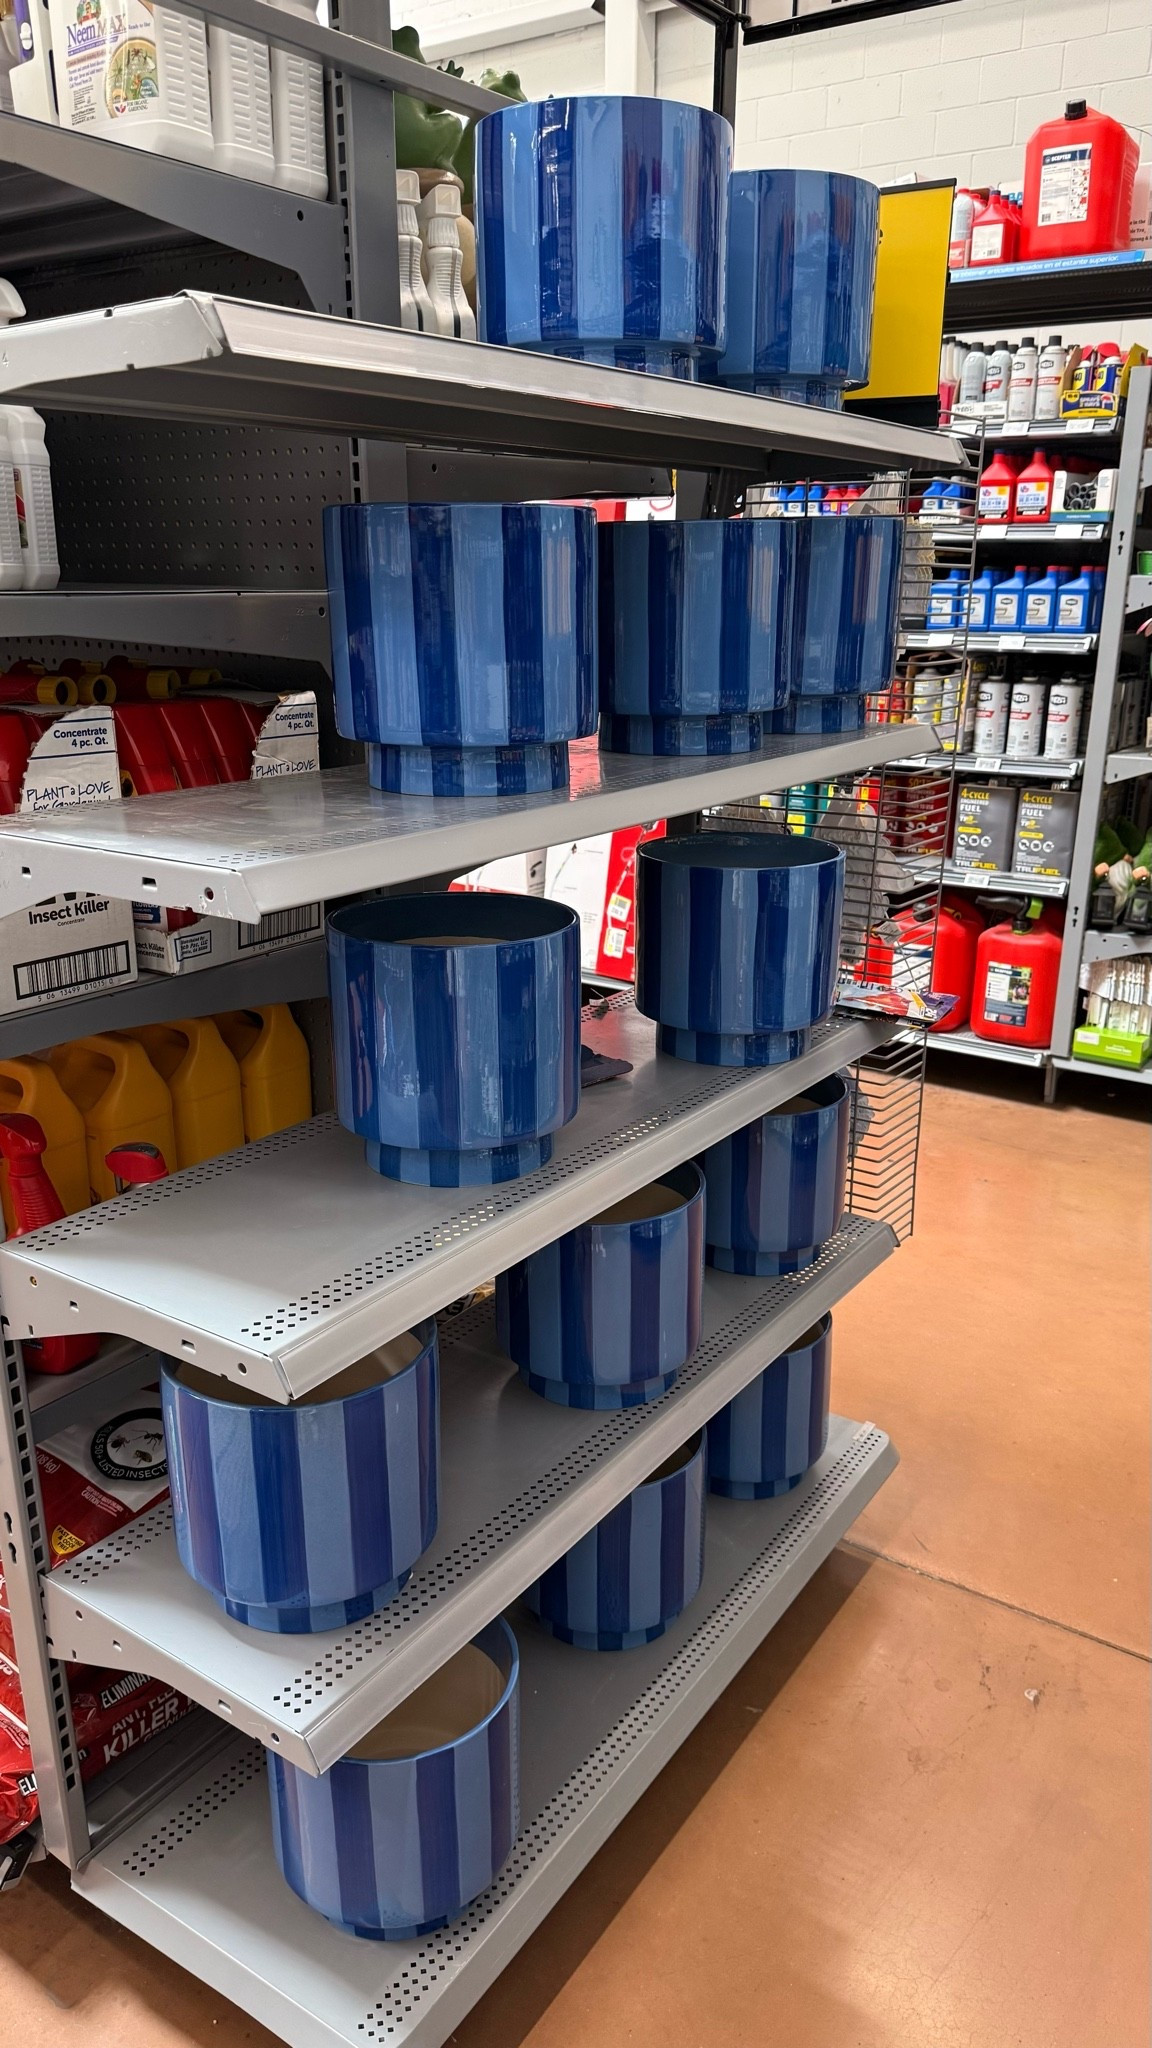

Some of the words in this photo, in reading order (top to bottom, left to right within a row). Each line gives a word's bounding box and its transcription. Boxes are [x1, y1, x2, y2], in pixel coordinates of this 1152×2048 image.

[1016, 262, 1043, 272] situados
[1062, 258, 1088, 266] estante
[1089, 255, 1119, 265] superior.
[275, 711, 314, 721] Concentrate
[288, 721, 292, 729] 4
[294, 722, 303, 731] pc.
[304, 720, 314, 728] Qt.
[53, 727, 108, 739] Concentrate
[71, 739, 77, 747] 4
[80, 739, 93, 749] pc.
[94, 736, 108, 746] Qt.
[255, 762, 286, 777] PLANT
[291, 759, 317, 773] LOVE
[26, 785, 70, 802] PLANT
[70, 787, 76, 796] a
[78, 780, 113, 796] LOVE
[961, 788, 990, 800] 4-CYCLE
[1022, 792, 1053, 804] 4-CYCLE
[960, 804, 982, 813] FUEL
[1021, 808, 1044, 817] FUEL
[955, 860, 998, 870] TRUFUEL
[1016, 865, 1061, 876] TRUFUEL
[28, 905, 72, 925] Insect
[74, 900, 110, 917] Killer
[57, 917, 86, 927] Concentrate
[46, 992, 56, 1000] 06
[60, 986, 81, 997] 13499
[84, 980, 105, 991] 01015
[98, 1459, 125, 1477] LISTED
[57, 1526, 70, 1538] FAST
[103, 1697, 179, 1765] KILLER
